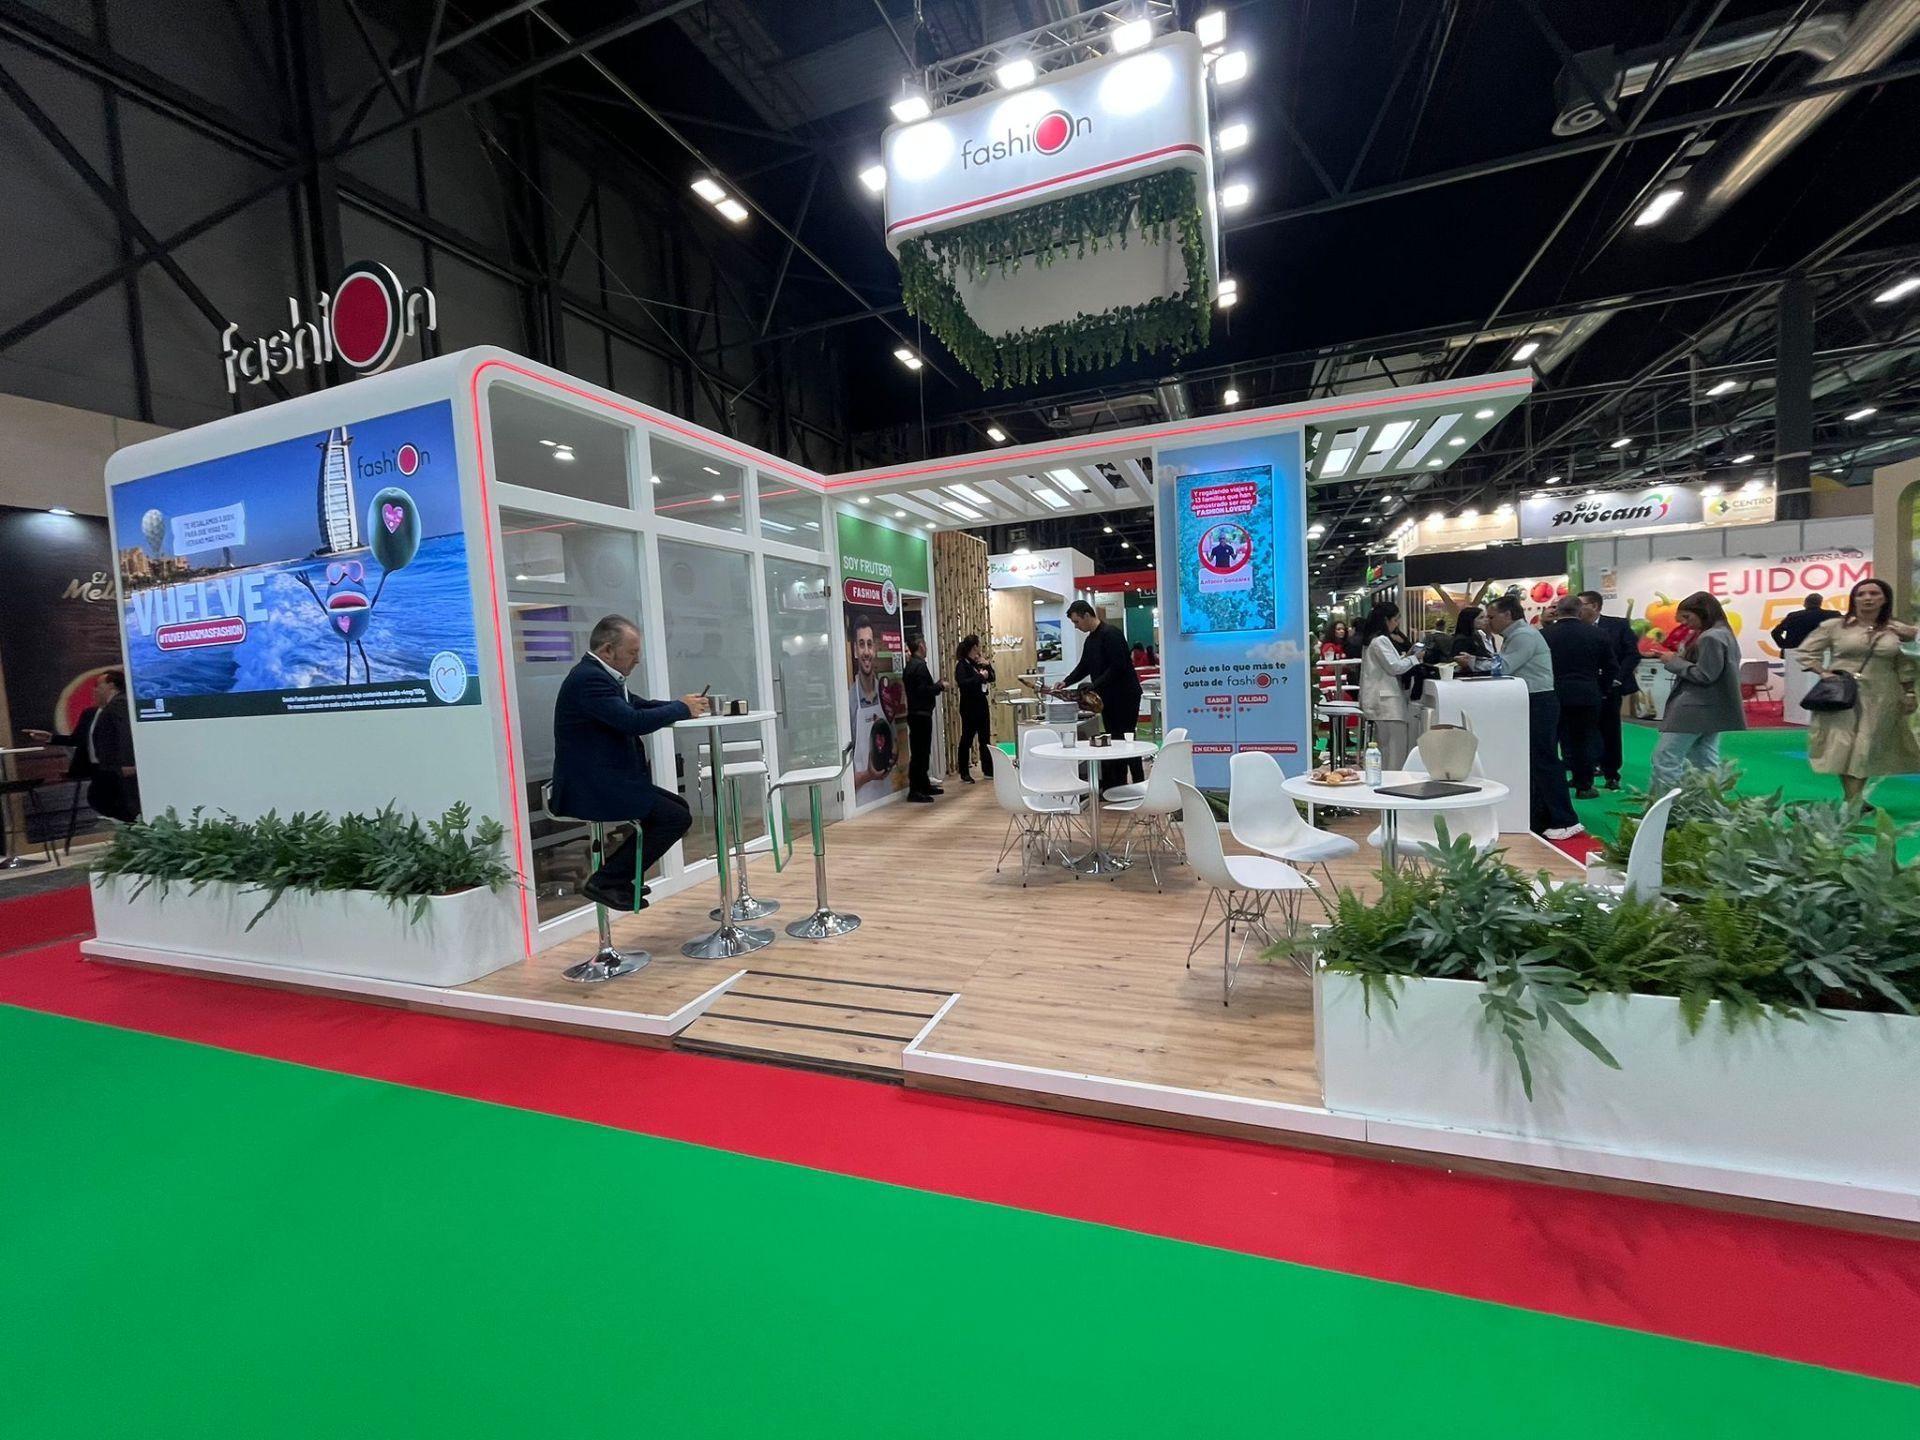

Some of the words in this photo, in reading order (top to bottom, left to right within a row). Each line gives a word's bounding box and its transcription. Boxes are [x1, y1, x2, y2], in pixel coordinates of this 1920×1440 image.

[1732, 496, 1774, 508] CENTRO
[1552, 504, 1653, 528] Procam
[1780, 549, 1864, 564] ANIVERSARIO
[843, 555, 859, 572] SOY
[860, 559, 893, 578] FRUTERO
[1708, 561, 1874, 597] EJIDOM
[852, 586, 881, 600] FASHION
[131, 573, 270, 636] VUELVE
[1222, 663, 1231, 671] lo
[1233, 664, 1251, 673] que
[1275, 661, 1286, 670] te
[1183, 679, 1209, 690] gusta
[1211, 678, 1223, 687] de
[1281, 676, 1288, 685] ?
[1207, 696, 1229, 704] SABOR
[1238, 695, 1267, 703] CALIDAD
